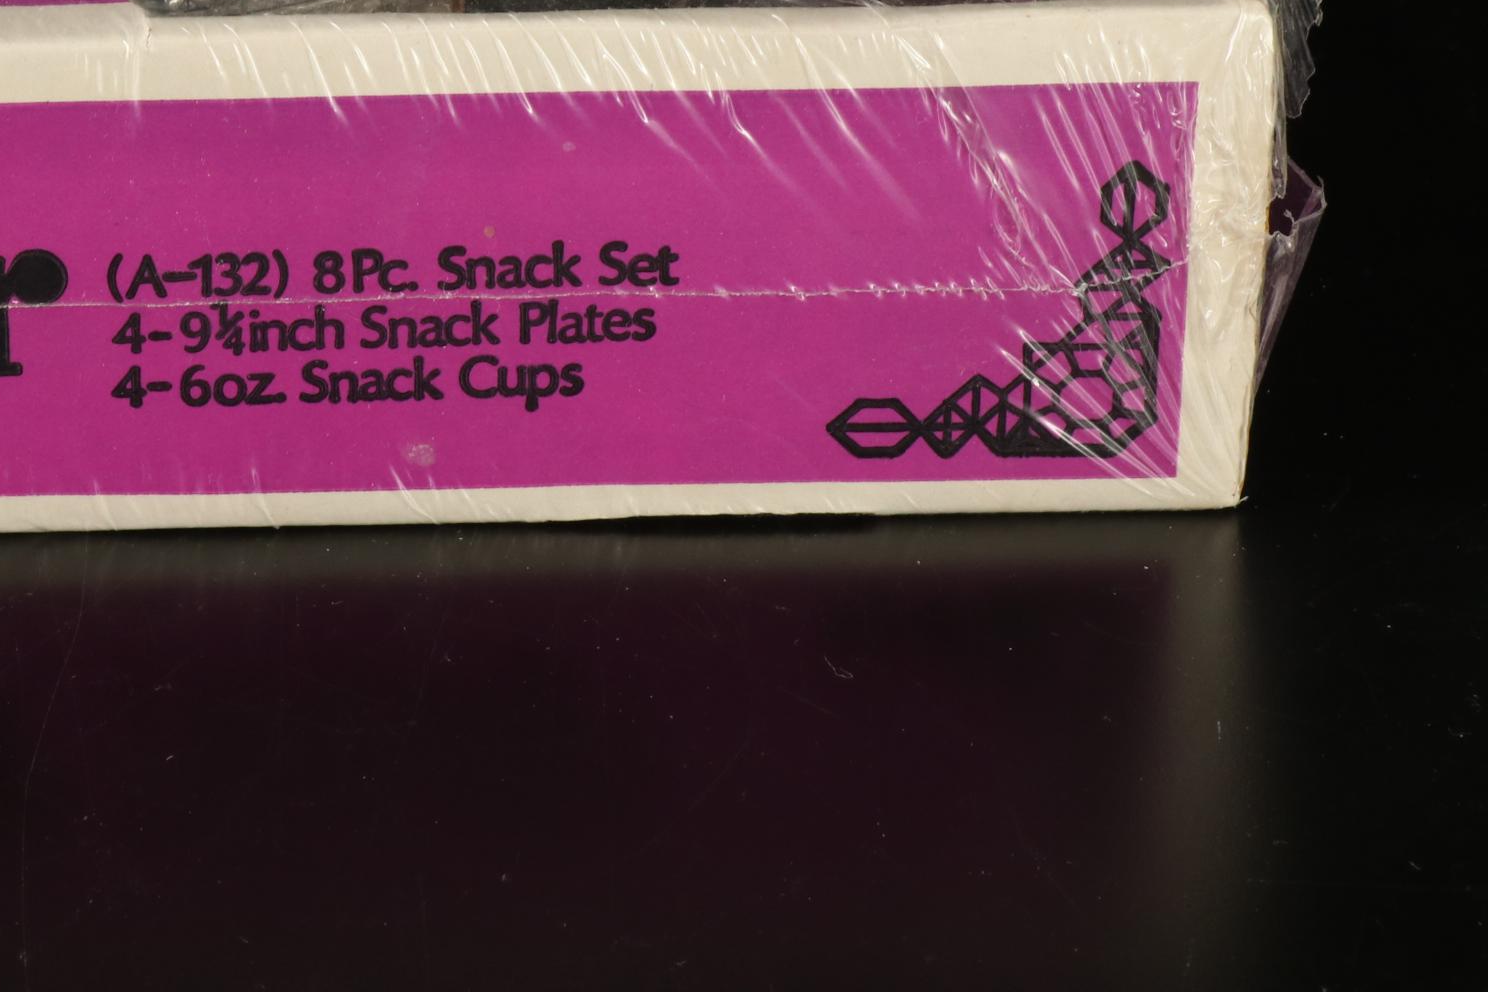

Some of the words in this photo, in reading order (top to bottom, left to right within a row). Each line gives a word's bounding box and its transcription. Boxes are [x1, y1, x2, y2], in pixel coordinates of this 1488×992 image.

[107, 250, 289, 303] (A-132)
[437, 240, 582, 291] Snack
[598, 240, 680, 288] Set
[360, 300, 501, 349] Snack
[519, 298, 657, 345] Plates
[299, 355, 444, 405] Snack
[458, 354, 585, 412] Cups
